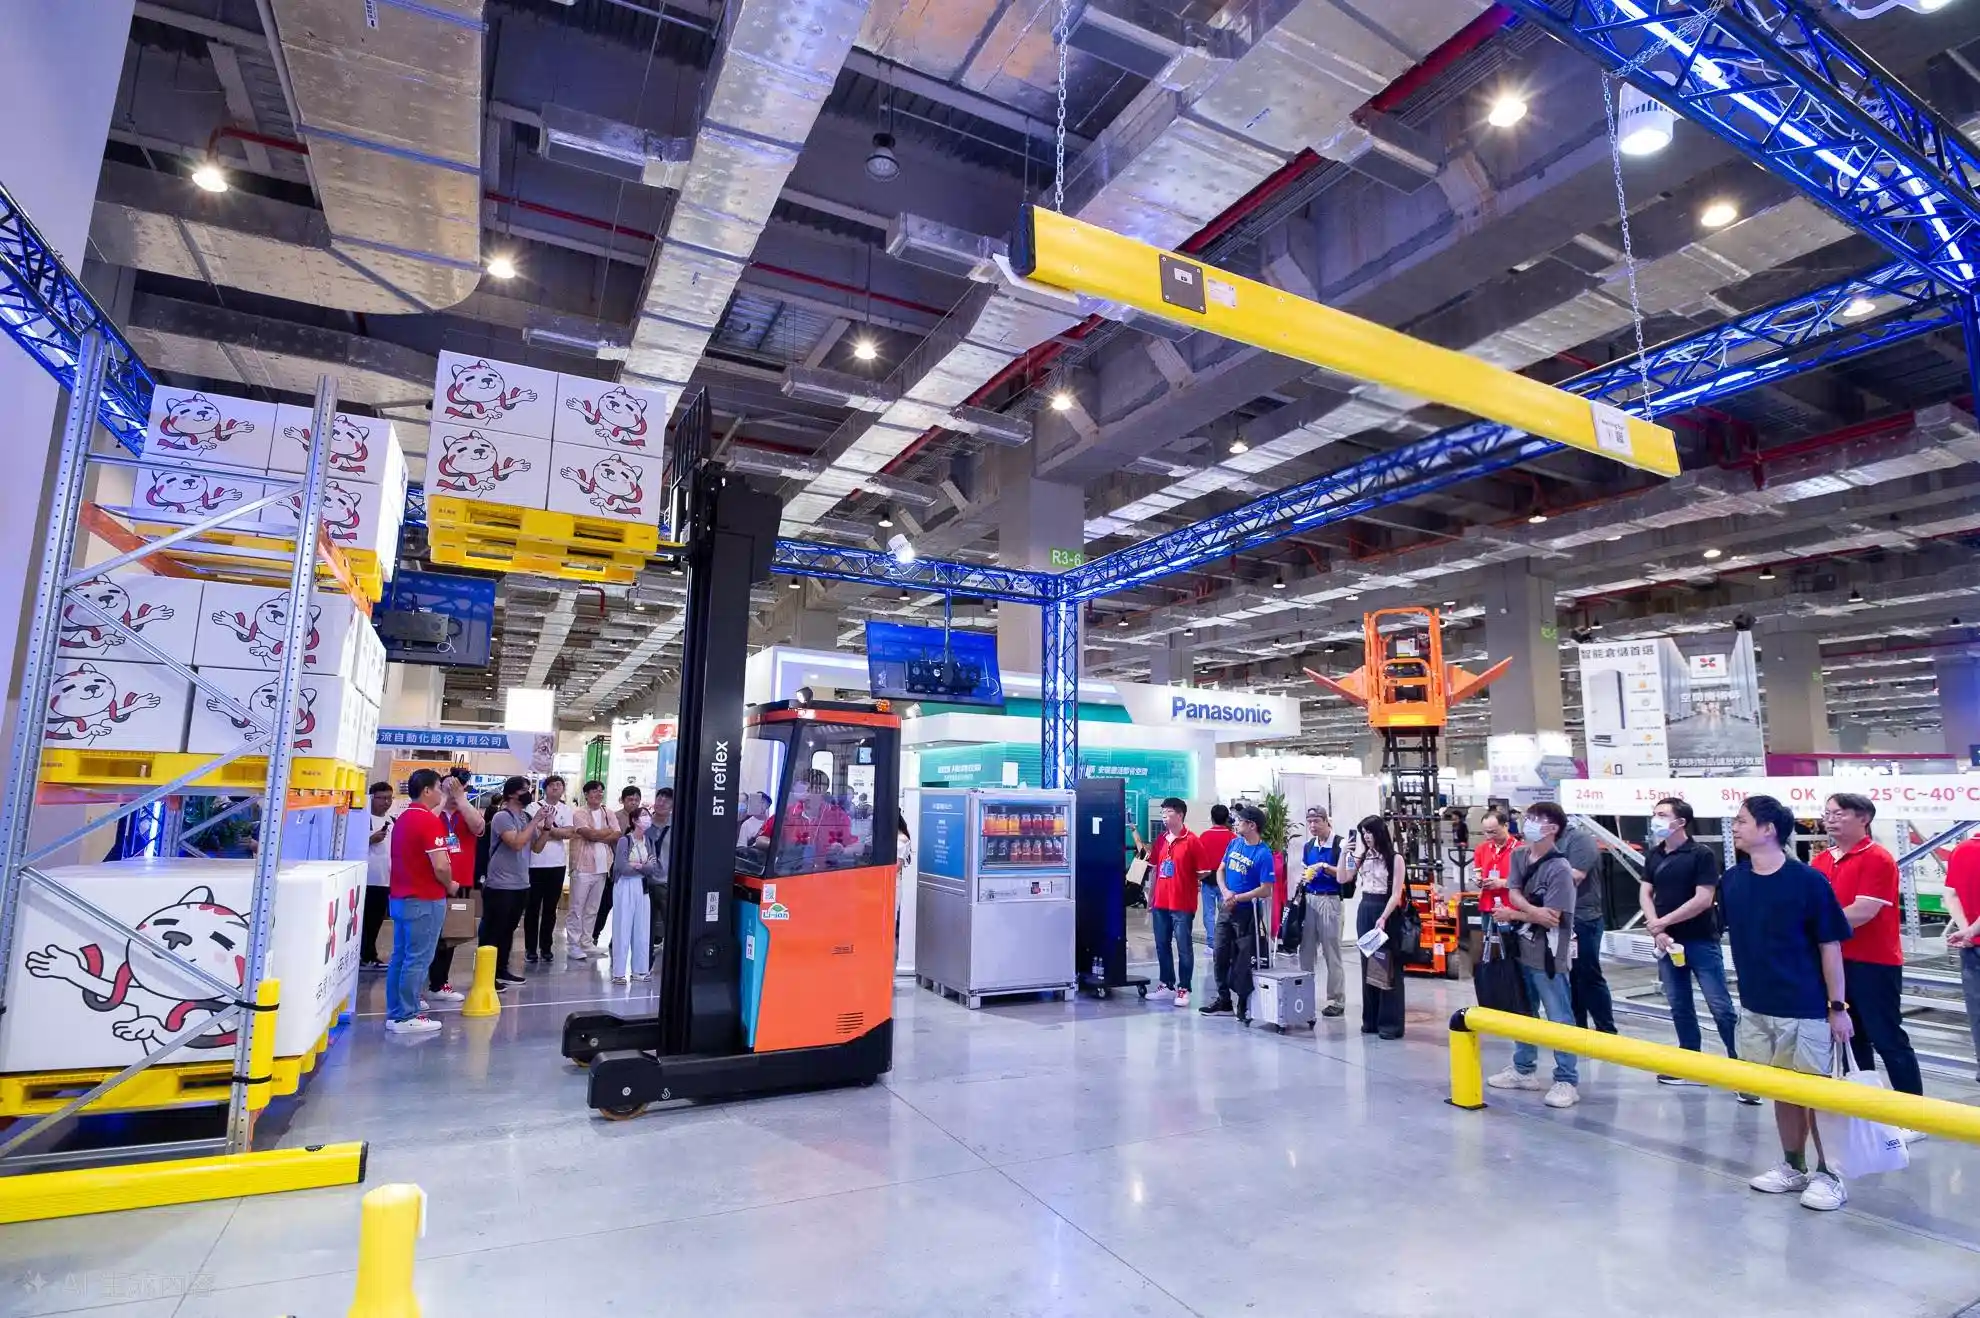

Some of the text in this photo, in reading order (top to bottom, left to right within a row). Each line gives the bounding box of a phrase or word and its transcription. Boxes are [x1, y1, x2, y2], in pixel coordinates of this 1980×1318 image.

[1052, 549, 1081, 567] R3-6
[1172, 696, 1272, 724] Panasonic
[711, 740, 729, 816] BT reflex
[1575, 789, 1604, 800] 24m
[1635, 788, 1685, 801] 1.5m/s
[1790, 788, 1817, 801] OK
